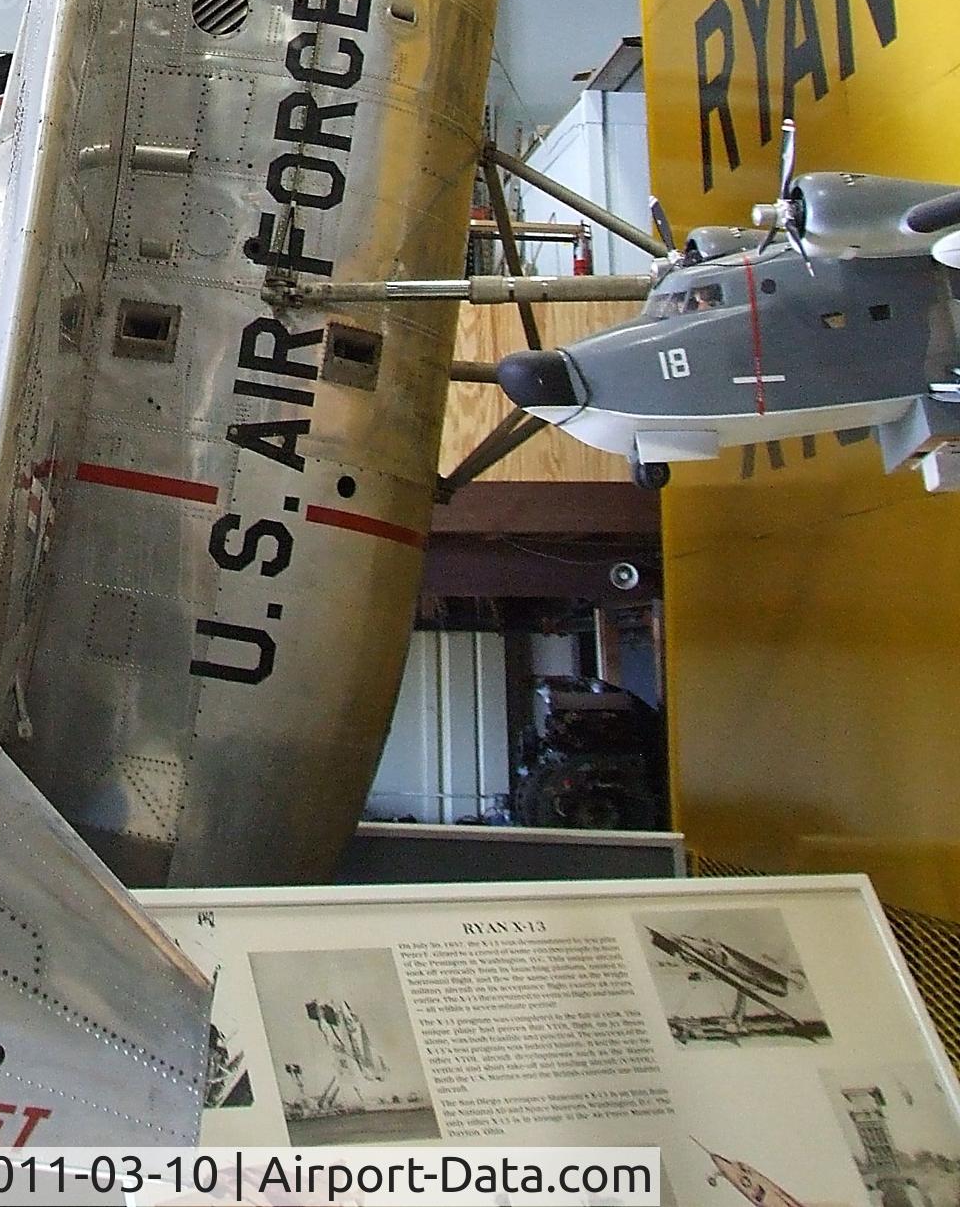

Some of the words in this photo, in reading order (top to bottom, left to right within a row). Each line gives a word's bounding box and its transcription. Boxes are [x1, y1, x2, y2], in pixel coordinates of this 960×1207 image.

[225, 317, 325, 473] AIR
[658, 348, 690, 380] 18
[189, 496, 301, 686] U.S.
[462, 922, 509, 935] RYAN
[512, 920, 547, 933] X-13
